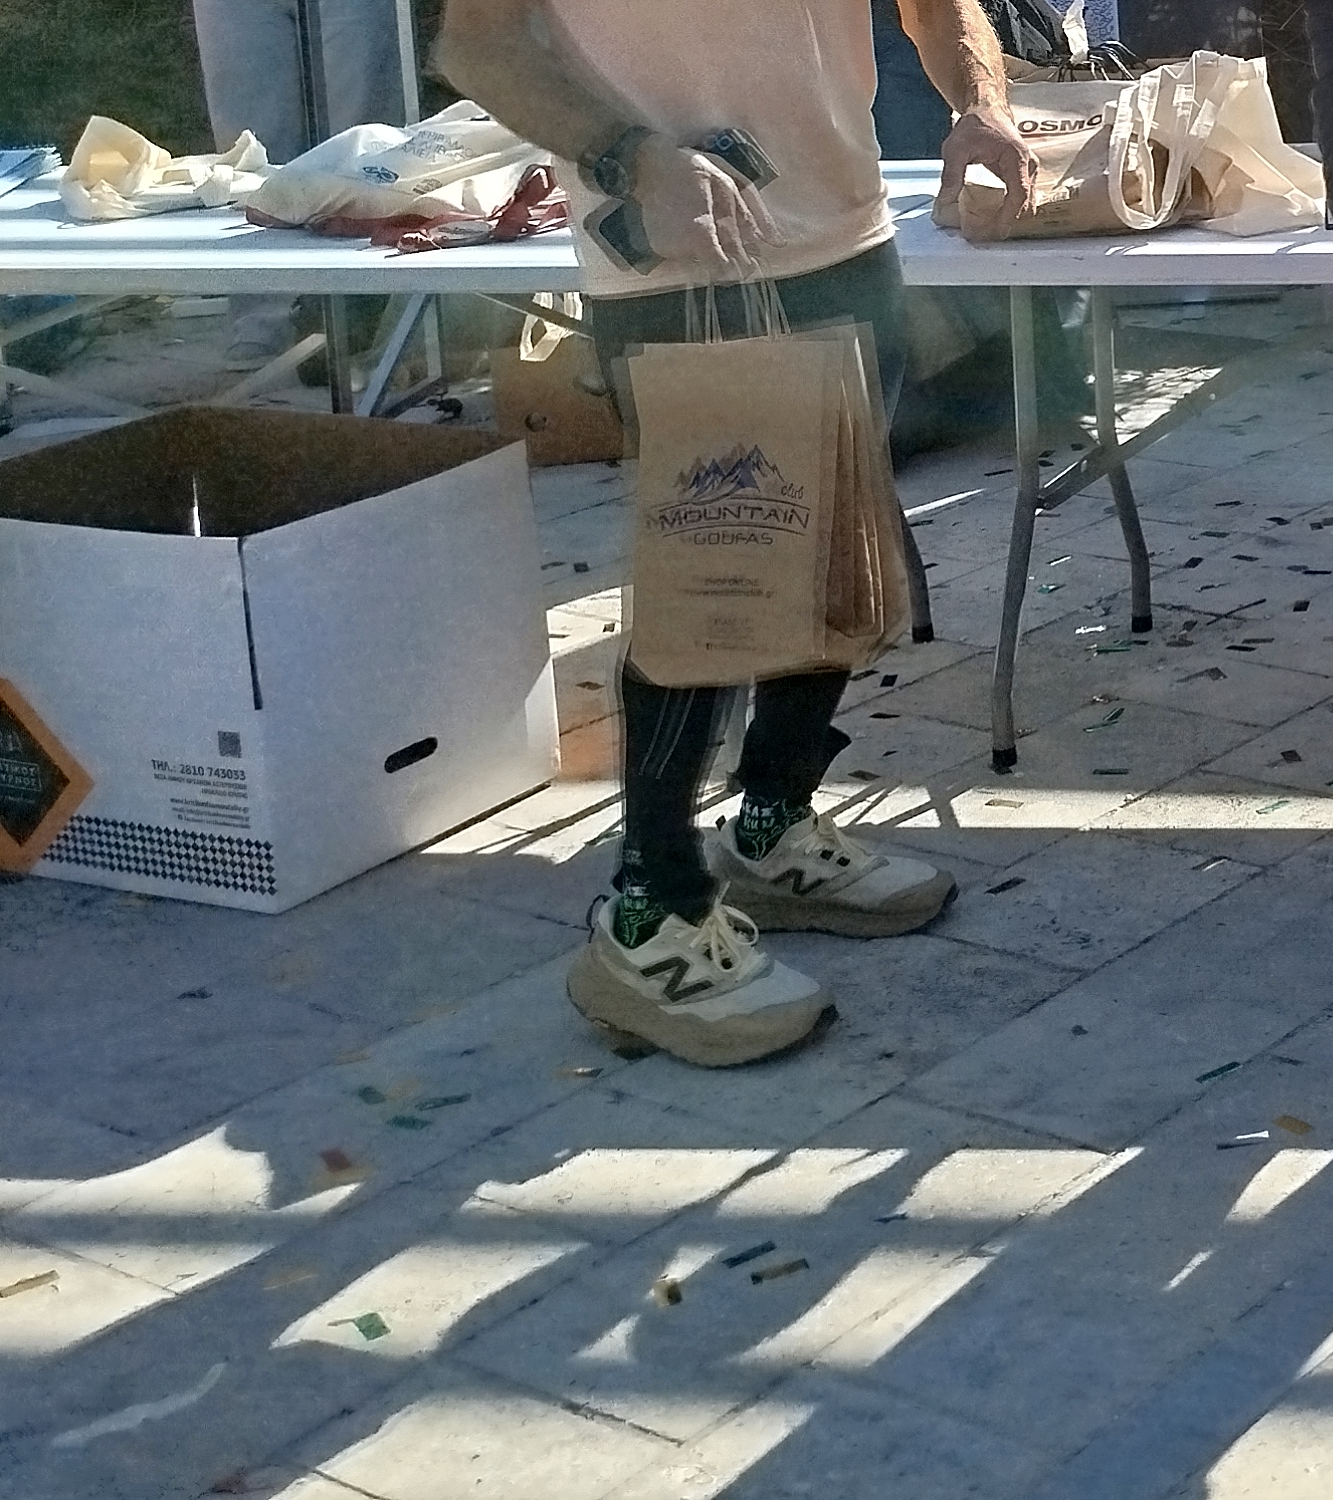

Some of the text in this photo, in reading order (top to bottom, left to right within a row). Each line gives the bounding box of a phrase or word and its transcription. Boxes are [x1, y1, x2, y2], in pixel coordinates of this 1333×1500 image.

[1015, 112, 1104, 135] OSMO
[658, 504, 810, 530] MOUNTAIN
[694, 532, 774, 546] GOUFAS
[180, 763, 205, 777] 2810
[207, 766, 247, 781] 743033
